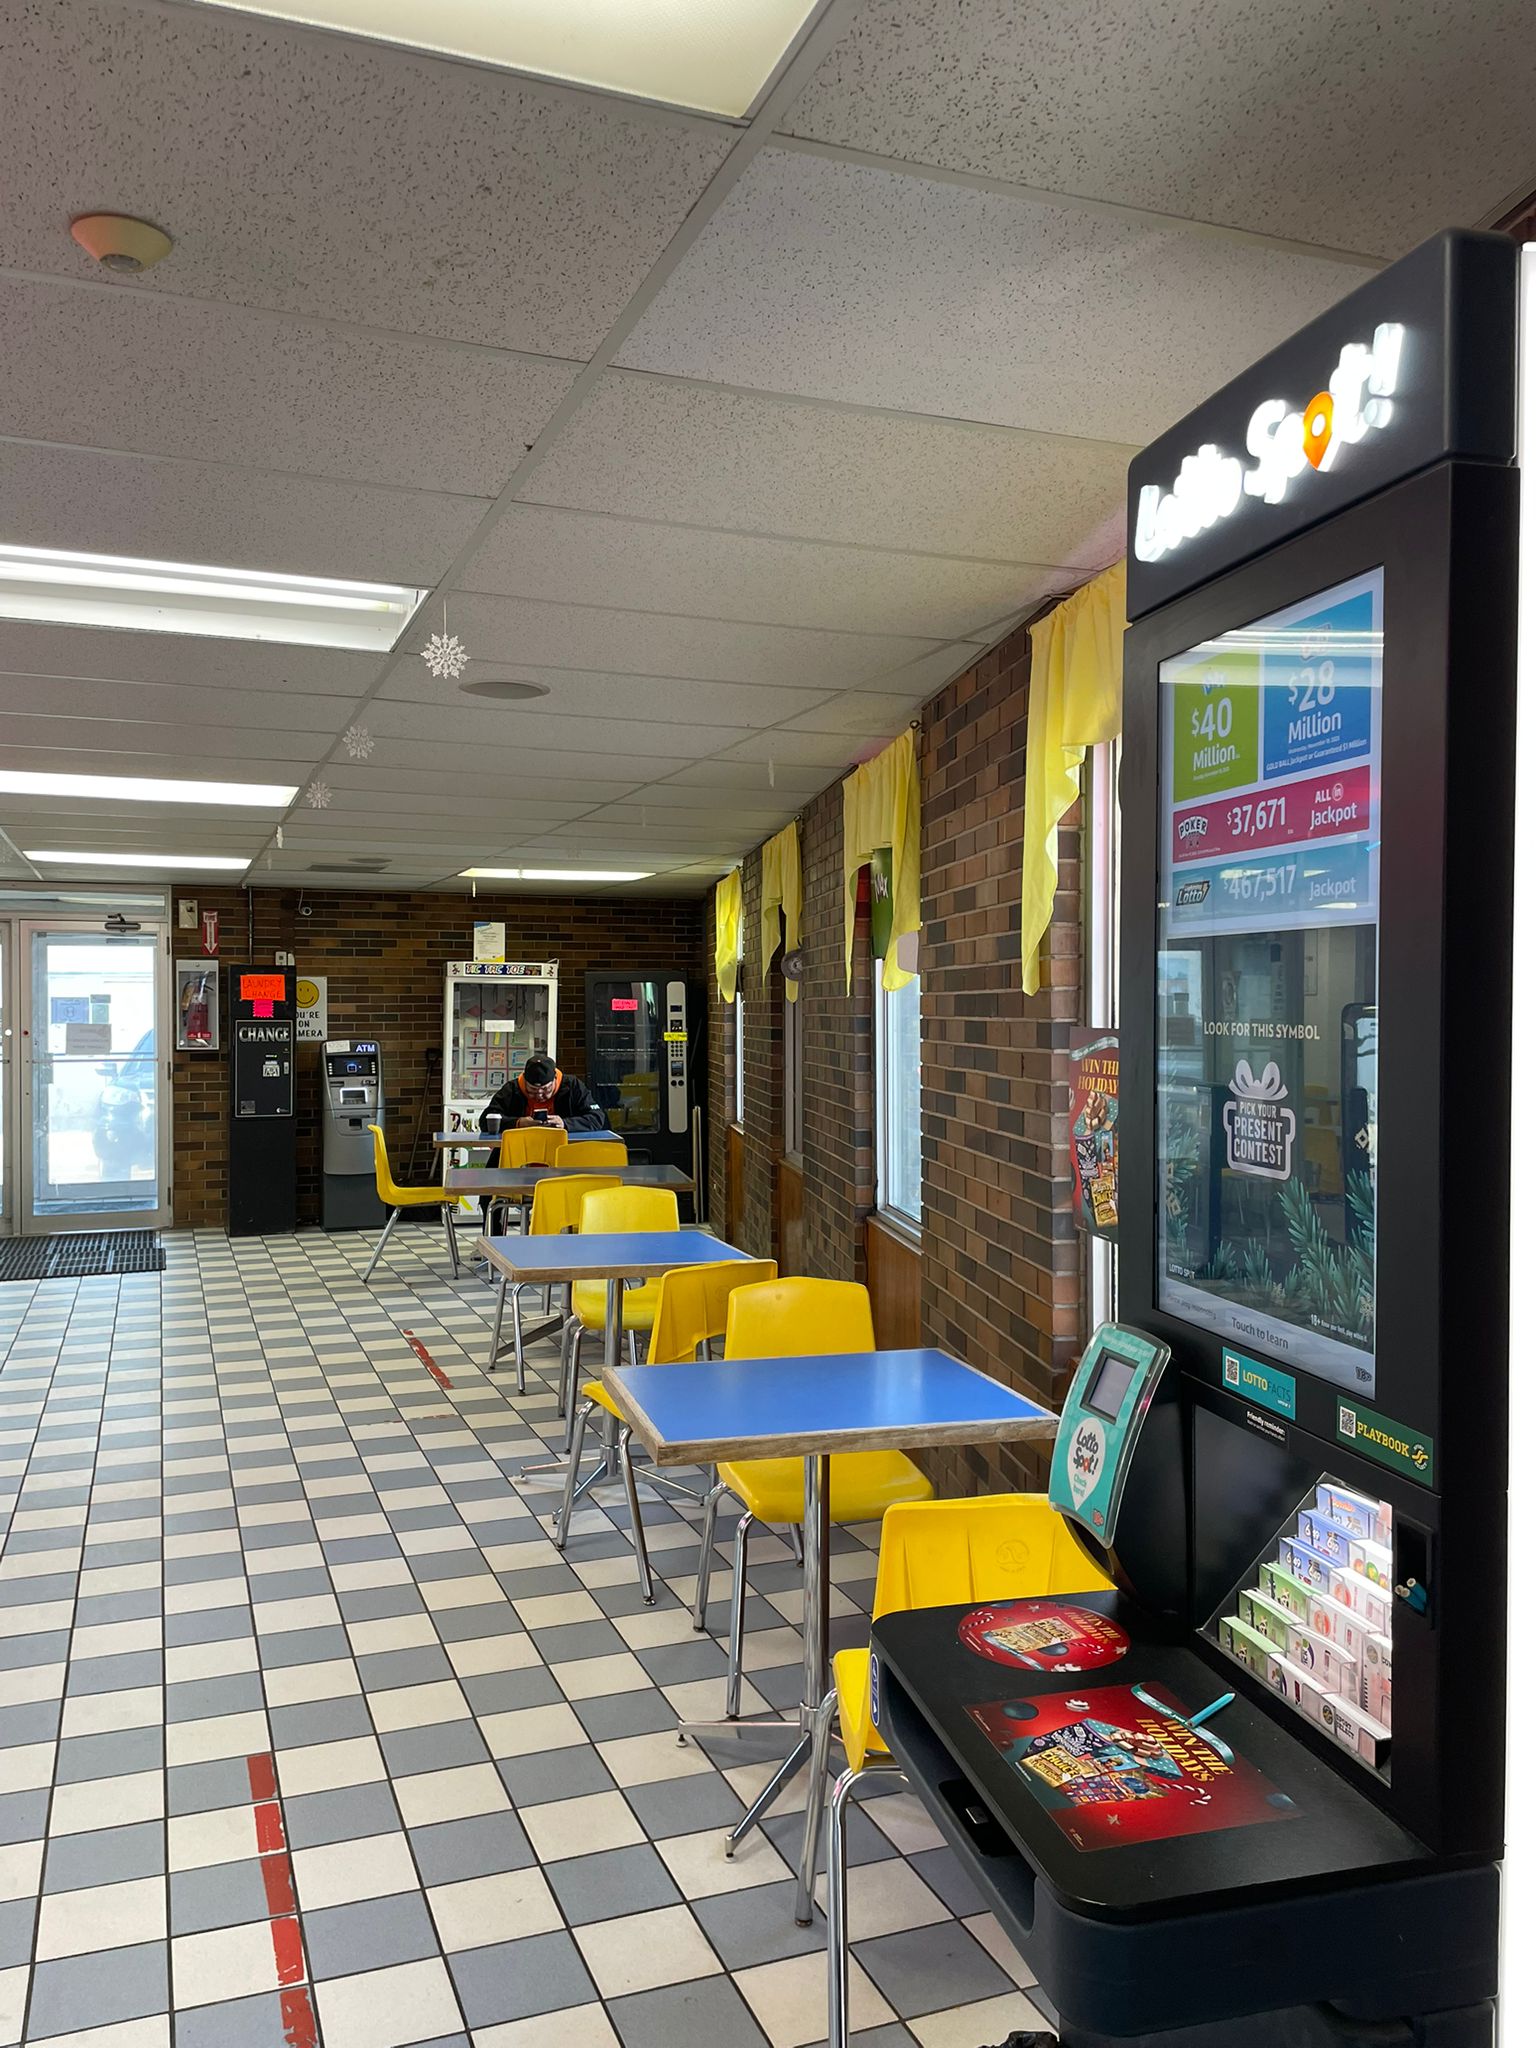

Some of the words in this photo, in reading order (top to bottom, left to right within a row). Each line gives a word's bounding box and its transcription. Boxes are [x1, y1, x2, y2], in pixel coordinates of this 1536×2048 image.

[1288, 660, 1336, 713] $28
[1191, 697, 1233, 741] $40
[1288, 711, 1342, 744] Million
[1193, 743, 1236, 771] Million
[1315, 789, 1331, 803] ALL
[1179, 817, 1207, 839] POKER
[1226, 797, 1286, 837] $37,671
[1309, 802, 1358, 831] Jackpot
[1178, 887, 1205, 905] Lotto
[1308, 877, 1357, 901] Jackpot
[466, 964, 482, 974] TIC
[484, 964, 503, 974] TAC
[506, 964, 526, 975] TOE
[243, 979, 283, 989] LAUNDRY
[239, 1027, 290, 1042] CHANGE
[1204, 1021, 1229, 1036] LOOK
[1231, 1022, 1250, 1037] FOR
[1252, 1023, 1274, 1038] THIS
[1276, 1024, 1320, 1040] SYMBOL
[355, 1044, 375, 1053] ATM
[1081, 1058, 1100, 1074] WIN
[1239, 1101, 1256, 1117] PICK
[1257, 1103, 1277, 1119] YOUR
[1234, 1115, 1283, 1143] PRESENT
[1234, 1137, 1283, 1165] CONTEST
[1231, 1316, 1255, 1336] Touch
[1257, 1328, 1265, 1339] to
[1266, 1330, 1288, 1349] learn
[1076, 1426, 1099, 1455] Lotto
[1357, 1421, 1410, 1457] PLAYBOOK
[1073, 1446, 1099, 1475] Spot!
[1135, 1718, 1216, 1783] HOLIDAYS
[1162, 1719, 1204, 1747] WIN
[1191, 1746, 1235, 1776] THE
